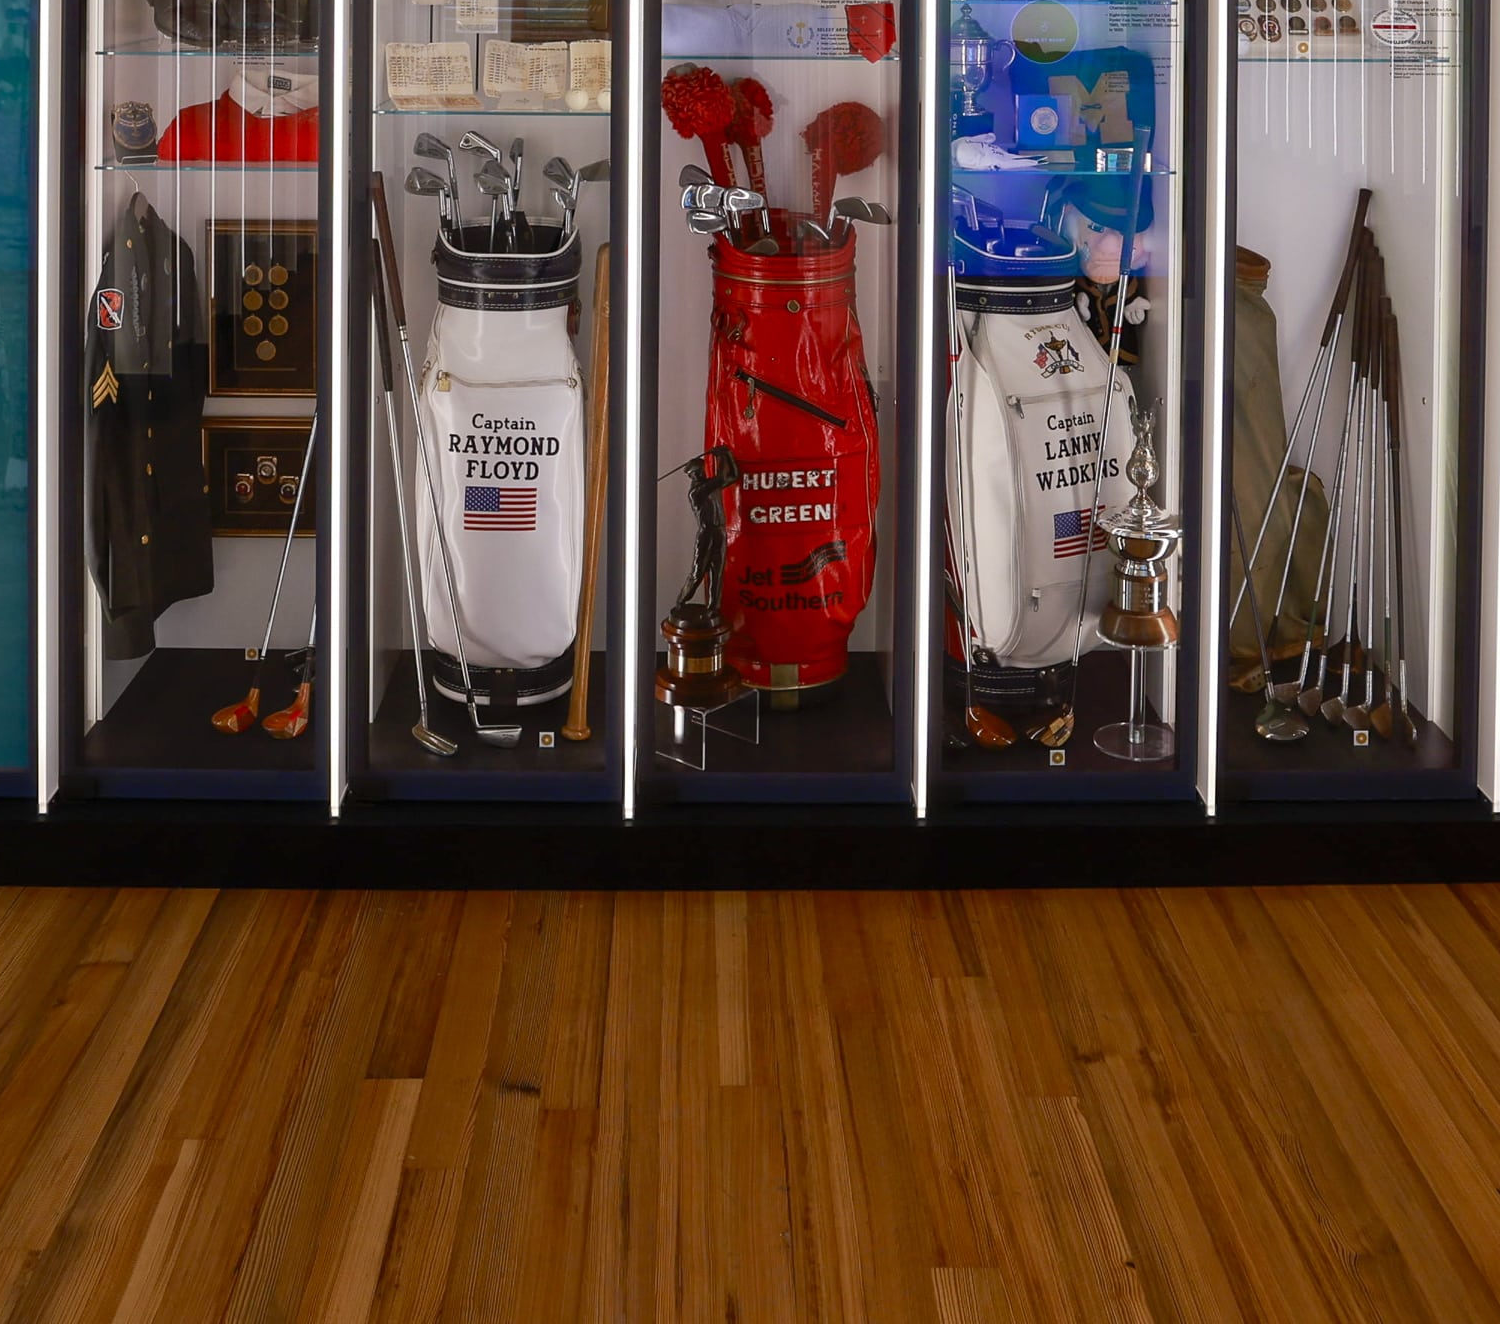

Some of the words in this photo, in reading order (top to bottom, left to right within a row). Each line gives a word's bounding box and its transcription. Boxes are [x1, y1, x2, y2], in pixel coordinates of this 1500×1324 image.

[472, 413, 536, 433] Captain
[1047, 411, 1095, 432] Captain
[448, 433, 560, 456] RAYMOND
[1045, 431, 1102, 461] LANNY
[465, 459, 539, 480] FLOYD
[742, 469, 835, 491] HUBERT
[1036, 458, 1120, 492] WADKINS
[749, 503, 832, 524] GREEN
[739, 566, 772, 586] Jet
[739, 590, 844, 612] Southern
